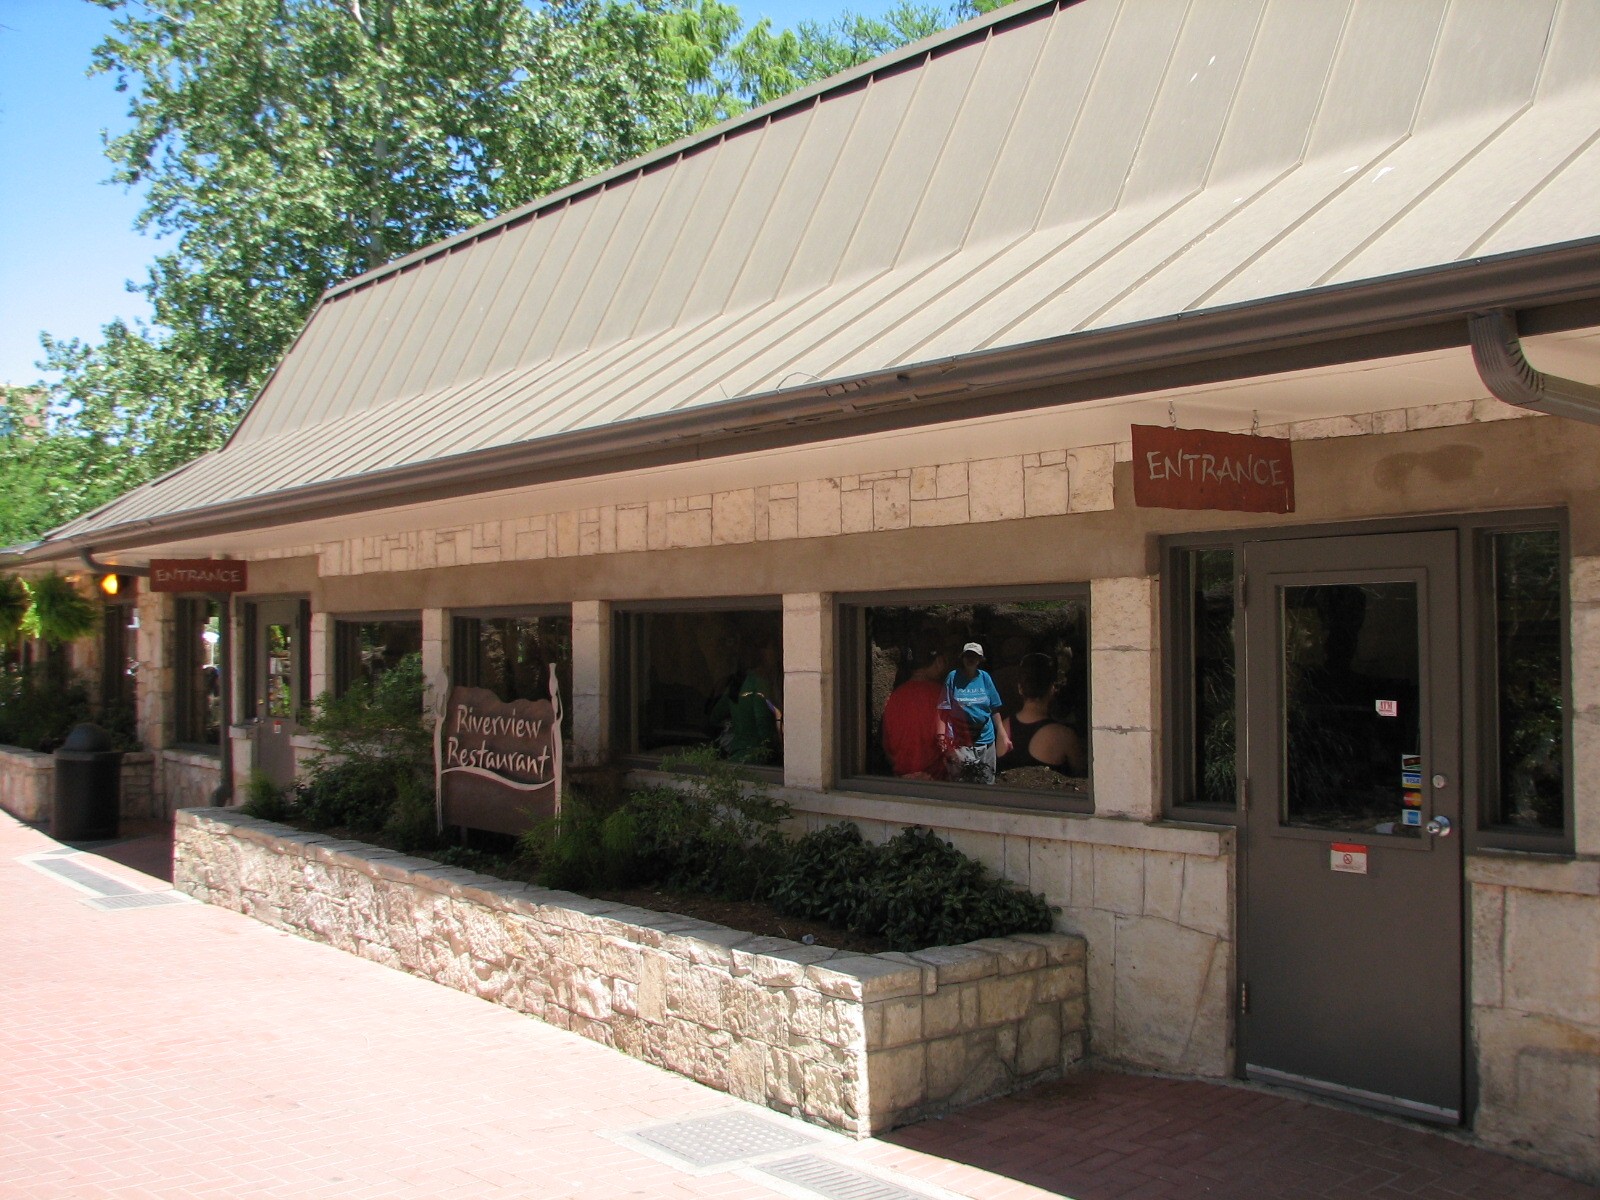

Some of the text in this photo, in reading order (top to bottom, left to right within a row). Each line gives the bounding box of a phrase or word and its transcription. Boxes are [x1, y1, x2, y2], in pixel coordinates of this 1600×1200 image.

[1146, 448, 1286, 486] ENTRANCE
[155, 568, 241, 582] ENTRANCE
[456, 704, 542, 739] Riverview
[447, 736, 551, 780] Restaurant
